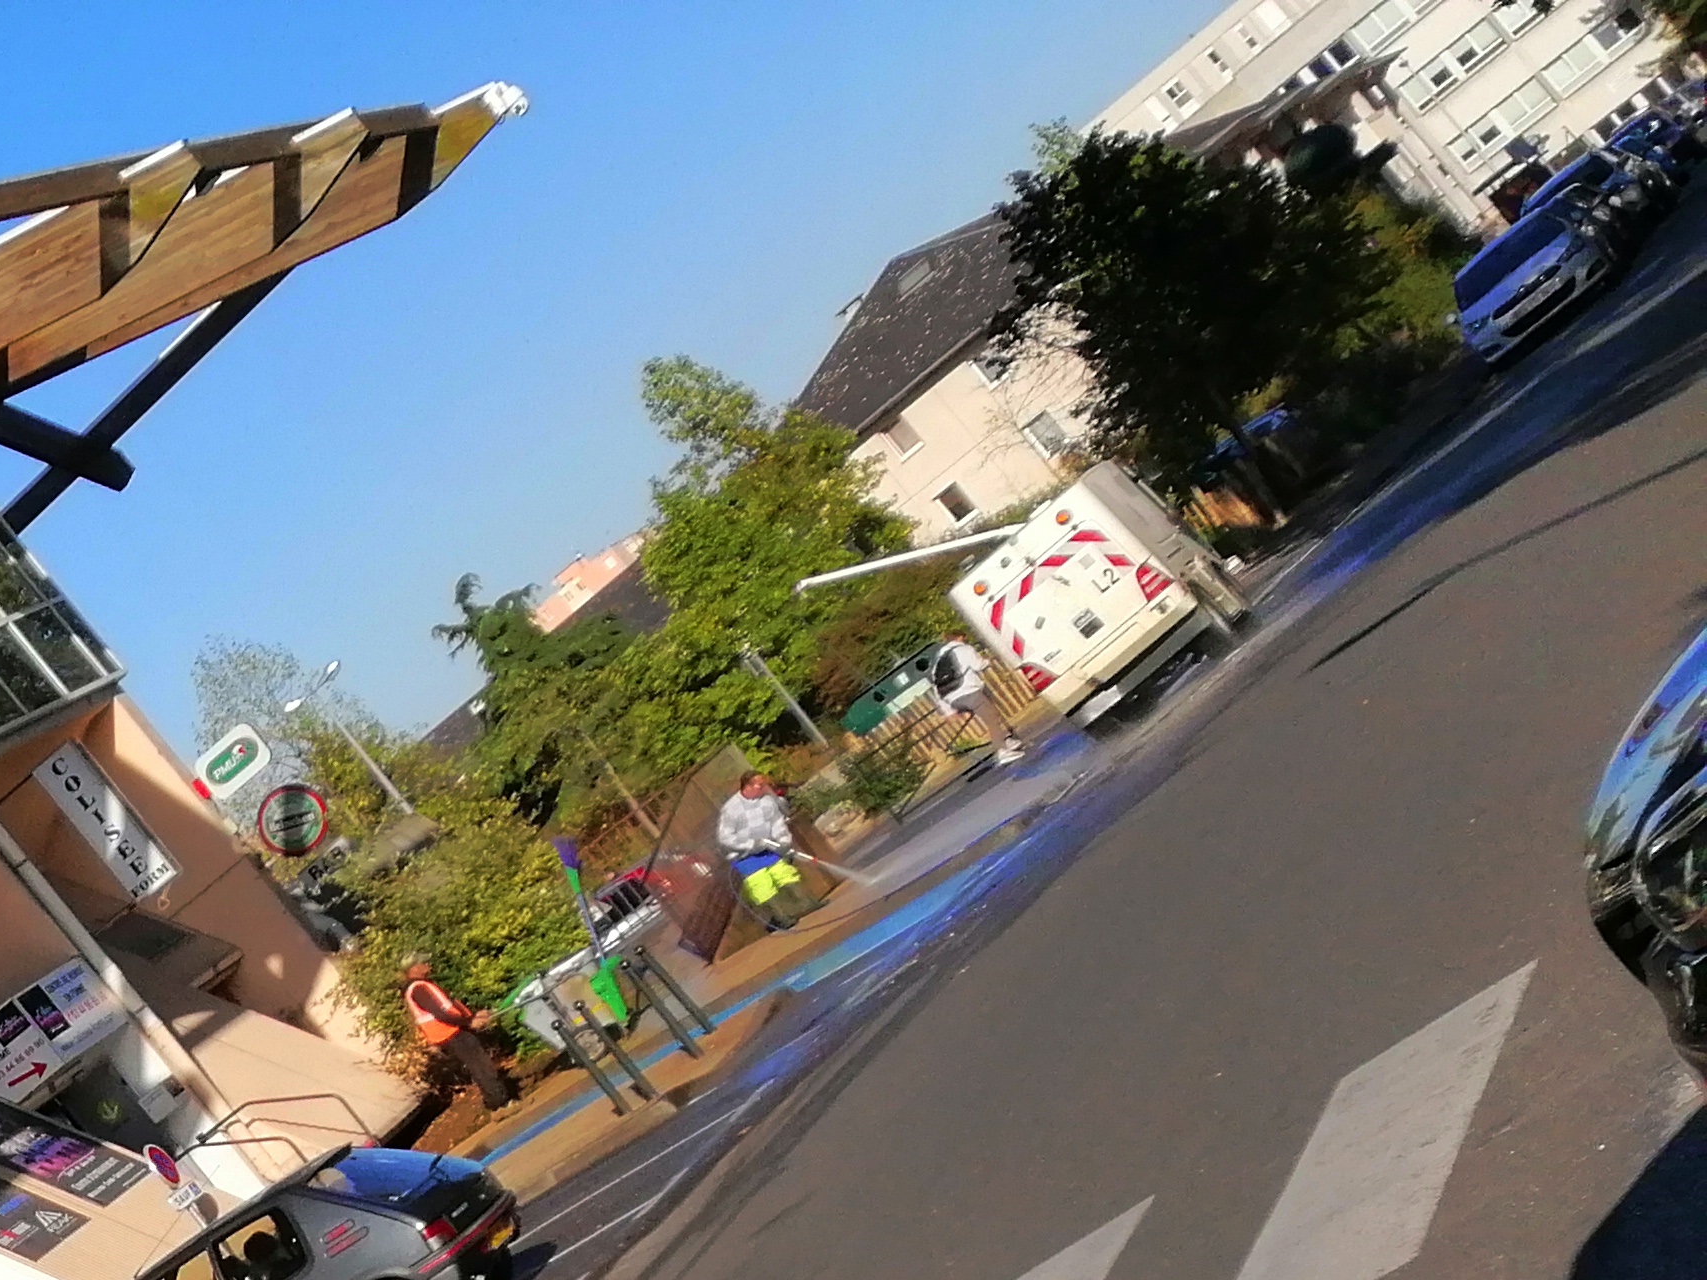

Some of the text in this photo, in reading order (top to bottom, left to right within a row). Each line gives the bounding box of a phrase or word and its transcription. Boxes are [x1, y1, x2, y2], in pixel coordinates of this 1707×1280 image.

[1090, 565, 1120, 594] L2
[211, 754, 239, 781] PMU
[130, 862, 171, 898] FORM
[173, 1189, 191, 1206] SAUF
